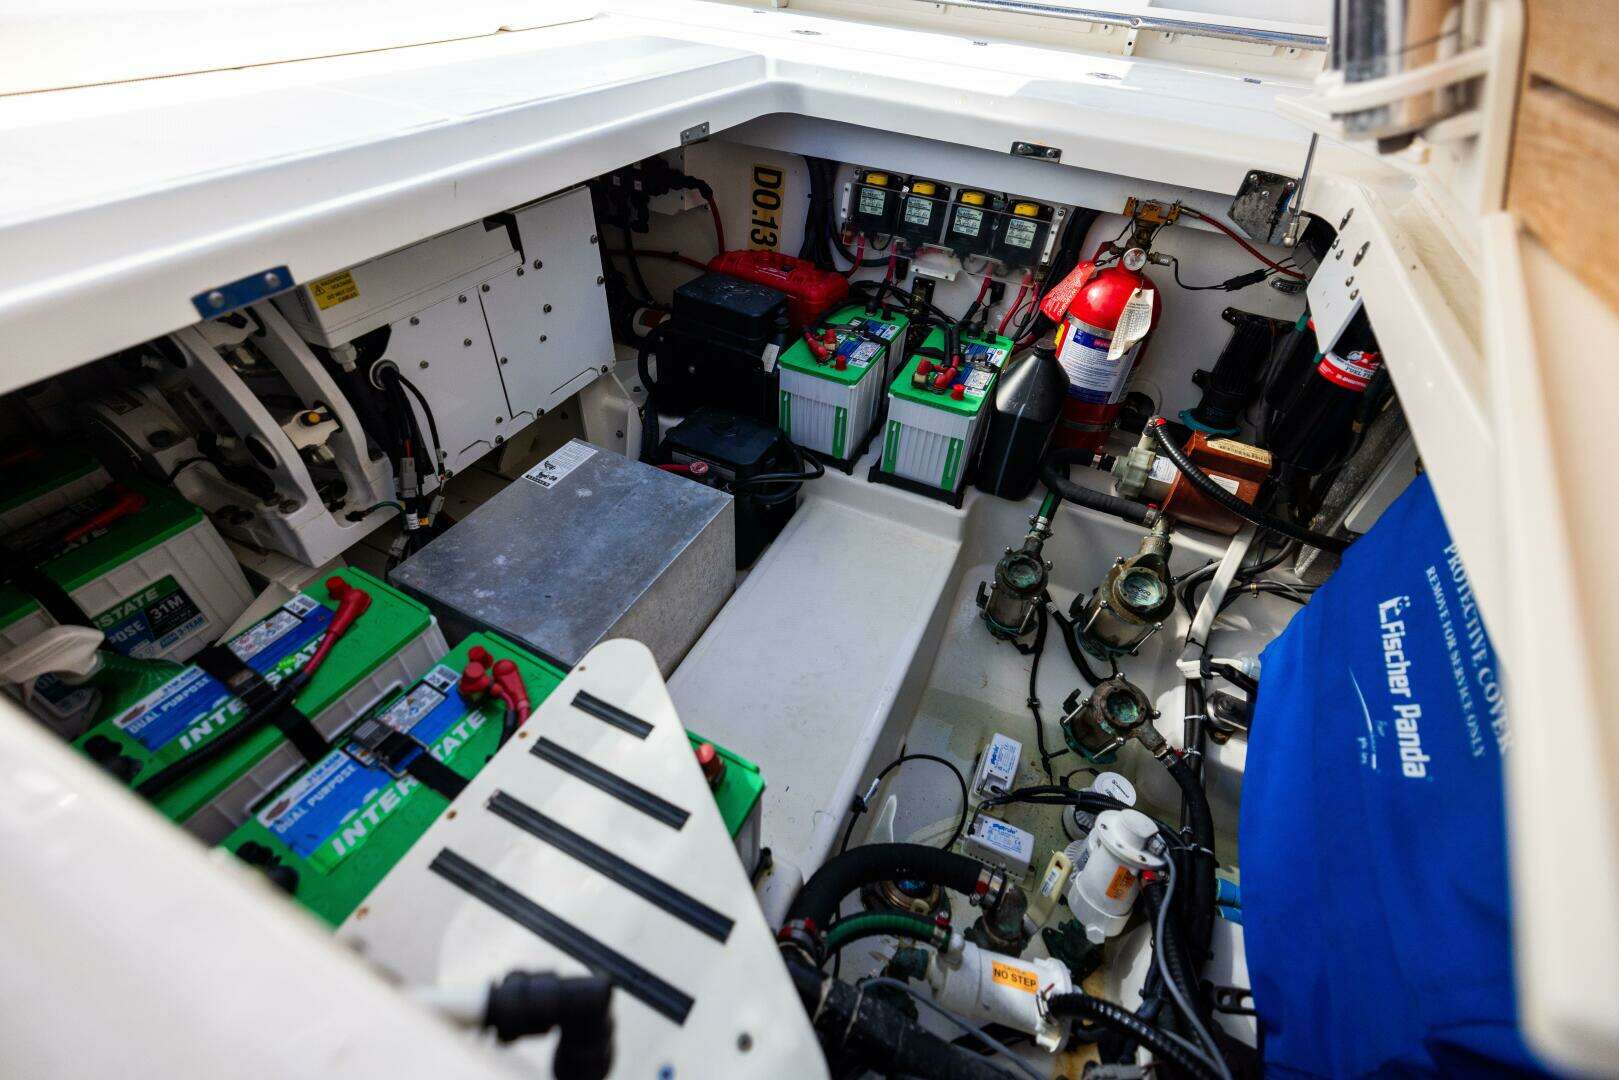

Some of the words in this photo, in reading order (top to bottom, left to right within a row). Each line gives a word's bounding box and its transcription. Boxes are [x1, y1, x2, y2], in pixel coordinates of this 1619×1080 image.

[149, 594, 185, 621] 31M
[1444, 543, 1488, 667] PROTECTIVE
[1381, 619, 1412, 698] Fischer
[1425, 565, 1450, 621] REMOVE
[1442, 621, 1458, 650] FOR
[1450, 650, 1474, 714] SERVICE
[1465, 714, 1486, 757] ONLY
[161, 675, 210, 711] PURPOSE
[1393, 704, 1431, 778] Panda
[307, 763, 357, 807] PURPOSE
[993, 968, 1009, 979] NO
[1011, 973, 1037, 987] STEP
